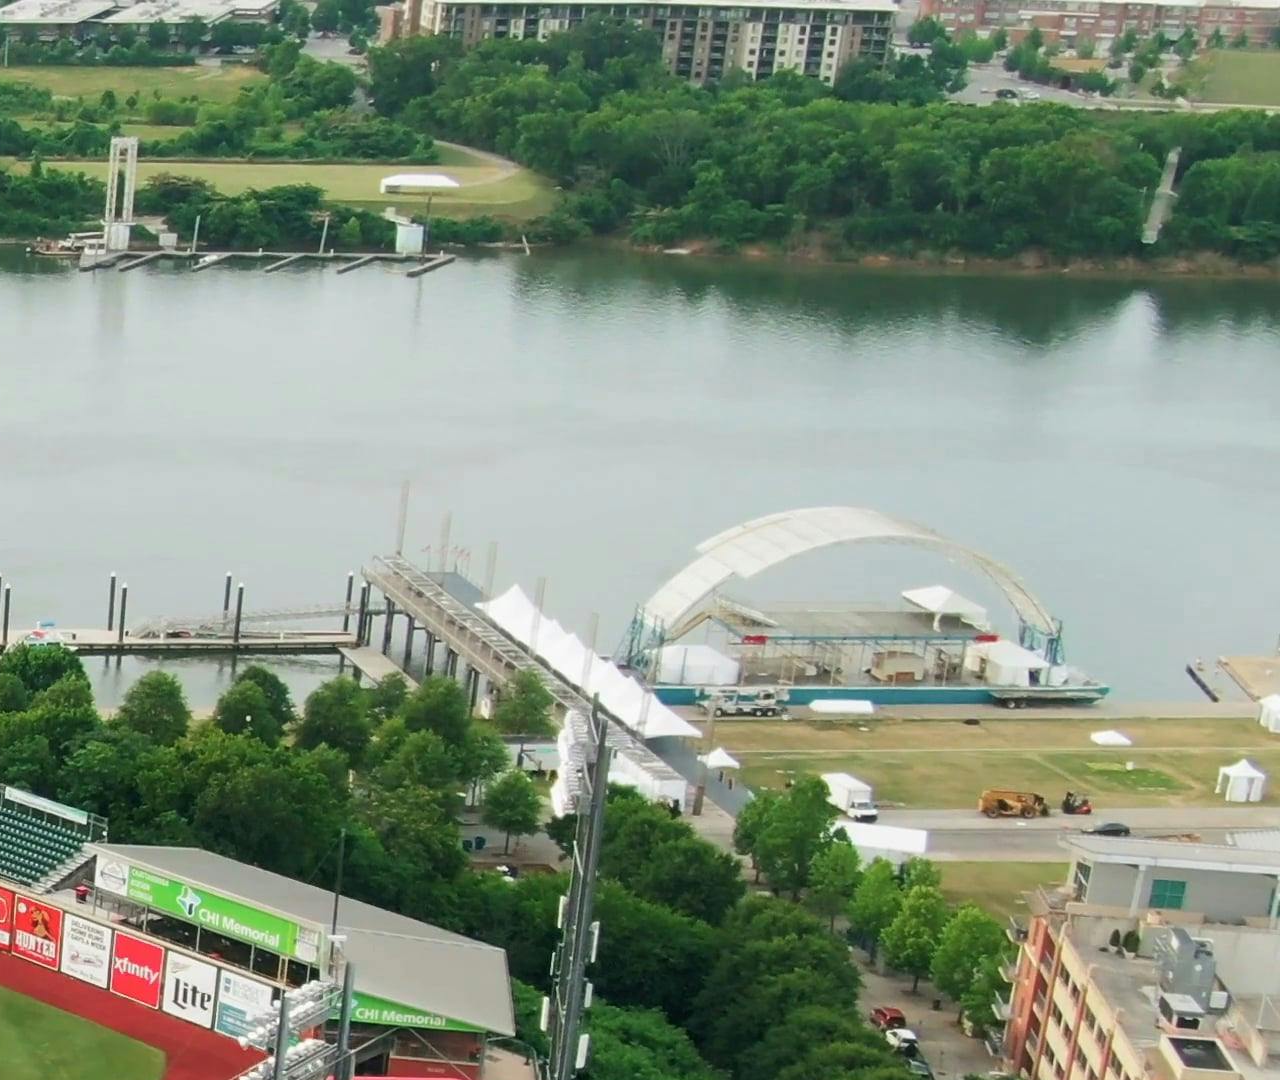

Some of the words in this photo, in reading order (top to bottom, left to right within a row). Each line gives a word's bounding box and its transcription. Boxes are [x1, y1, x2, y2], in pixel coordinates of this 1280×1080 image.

[198, 908, 220, 926] CHI
[222, 915, 280, 948] Memorial
[15, 929, 56, 959] HUNTER
[113, 956, 160, 985] xfinity
[172, 977, 212, 1011] Lite
[355, 1007, 378, 1021] CHI
[382, 1010, 446, 1026] Memorial
